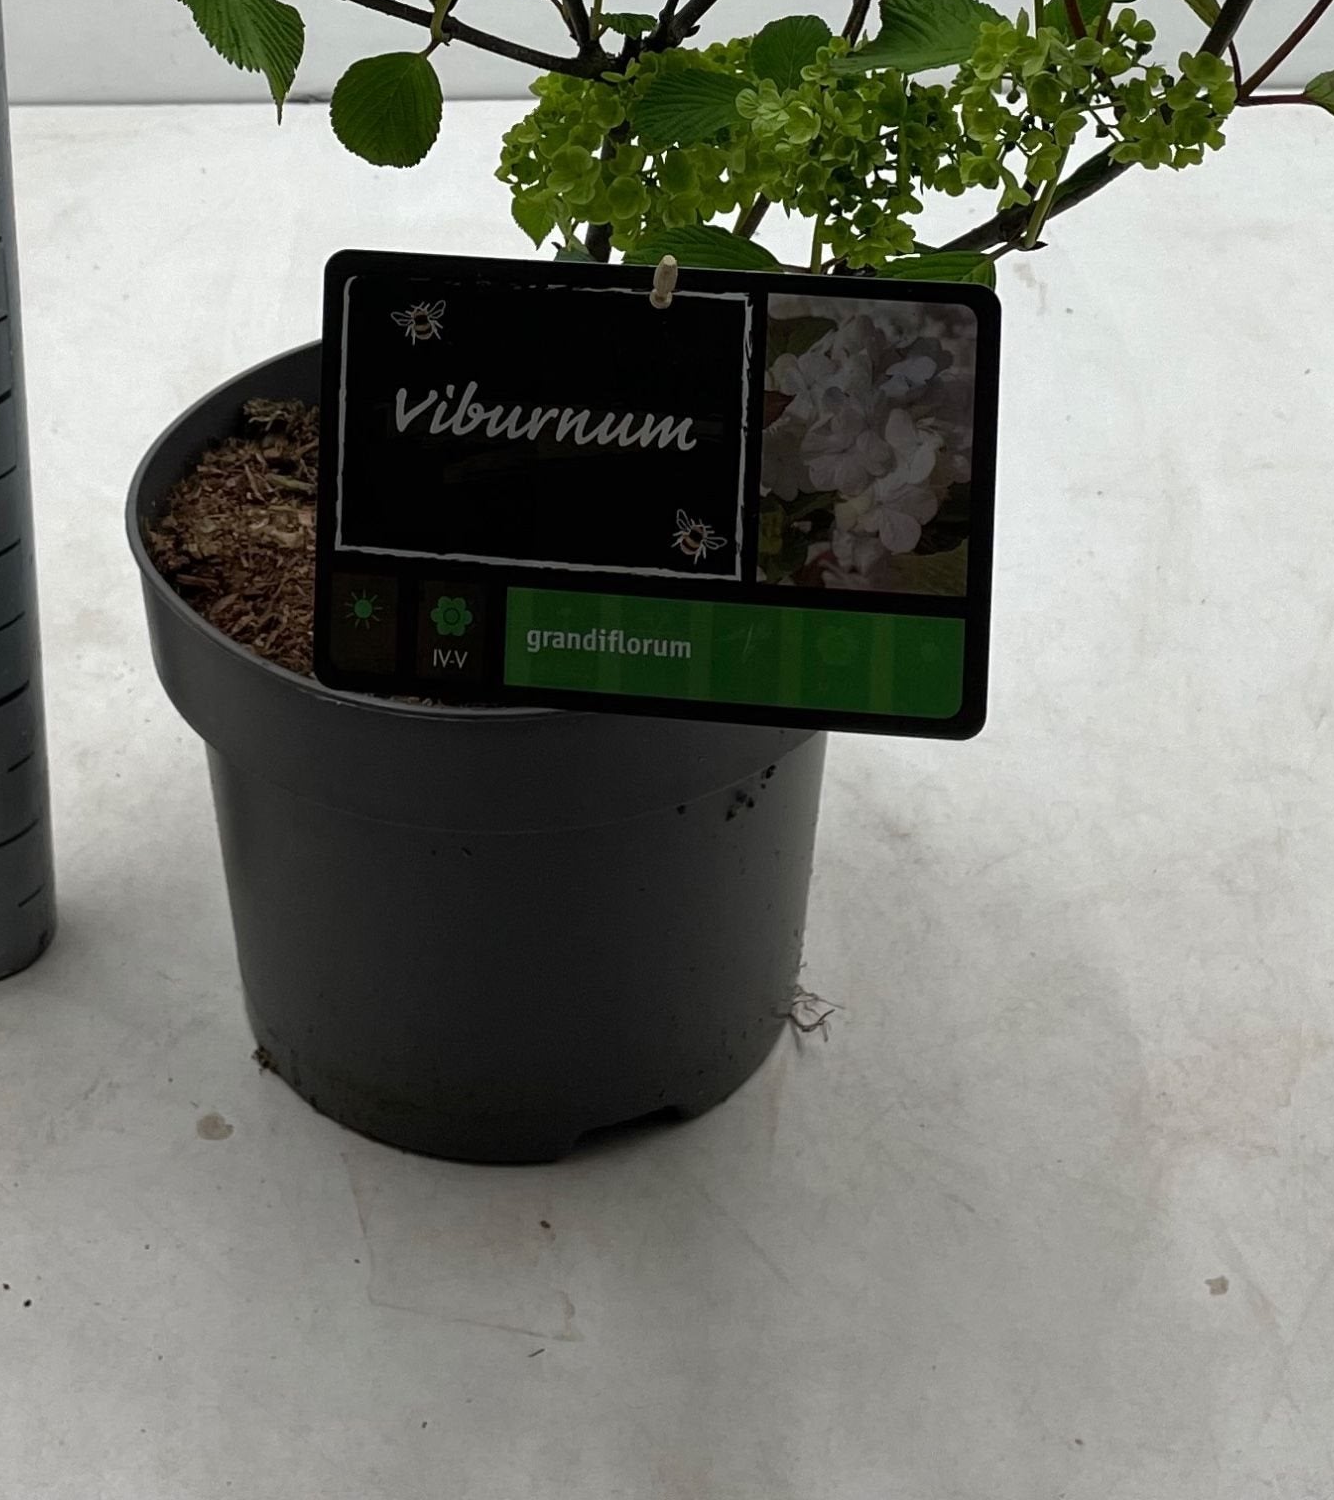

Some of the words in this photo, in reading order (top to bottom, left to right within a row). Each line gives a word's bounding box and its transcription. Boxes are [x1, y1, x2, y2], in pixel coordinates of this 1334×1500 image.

[396, 382, 697, 450] Viburnum
[526, 628, 692, 658] grandiflorum
[433, 648, 468, 669] IV-V
